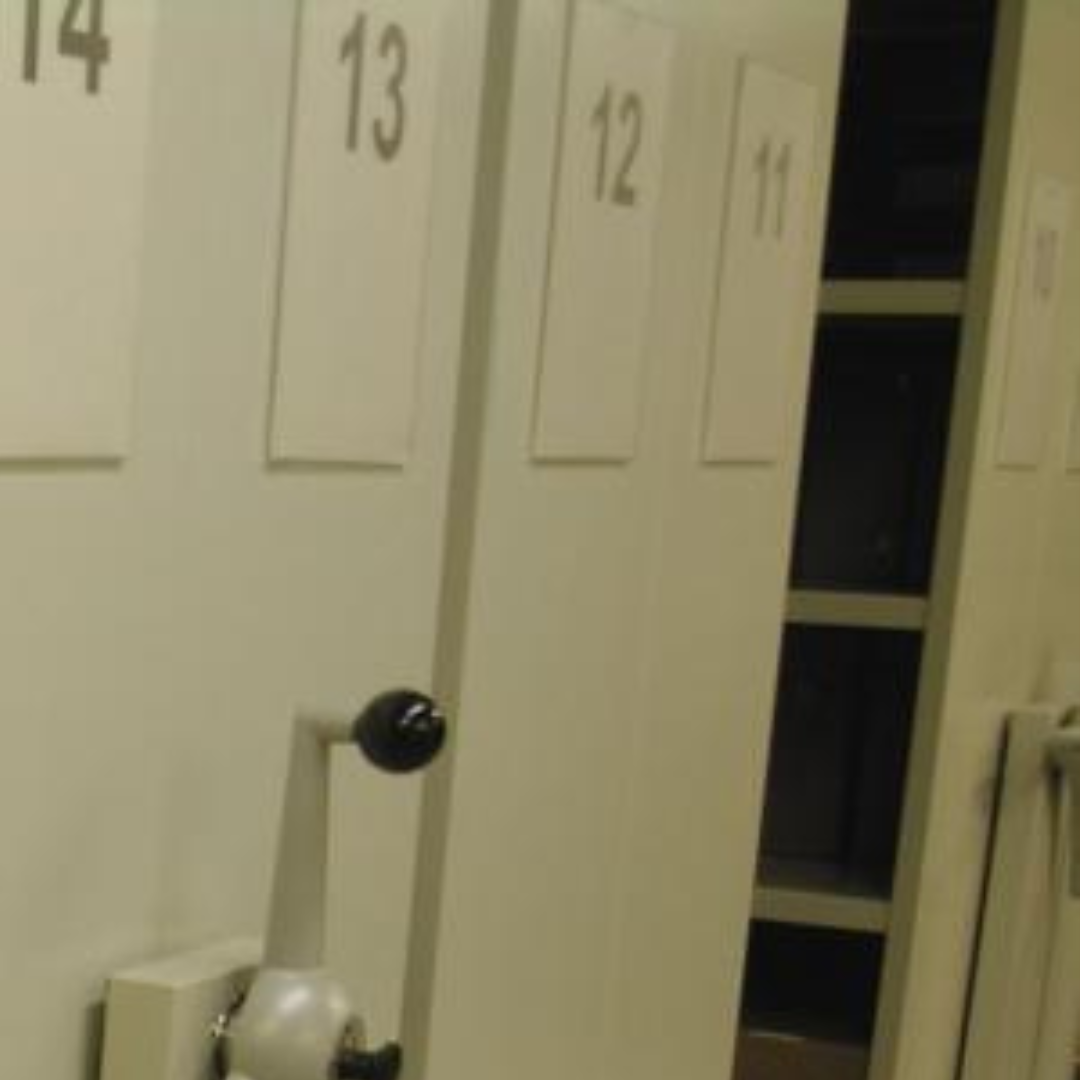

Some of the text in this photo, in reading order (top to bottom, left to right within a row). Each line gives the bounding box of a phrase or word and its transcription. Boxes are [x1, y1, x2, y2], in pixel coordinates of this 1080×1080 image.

[21, 0, 110, 95] 14
[339, 12, 408, 162] 13
[590, 83, 642, 206] 12
[754, 140, 791, 239] 11
